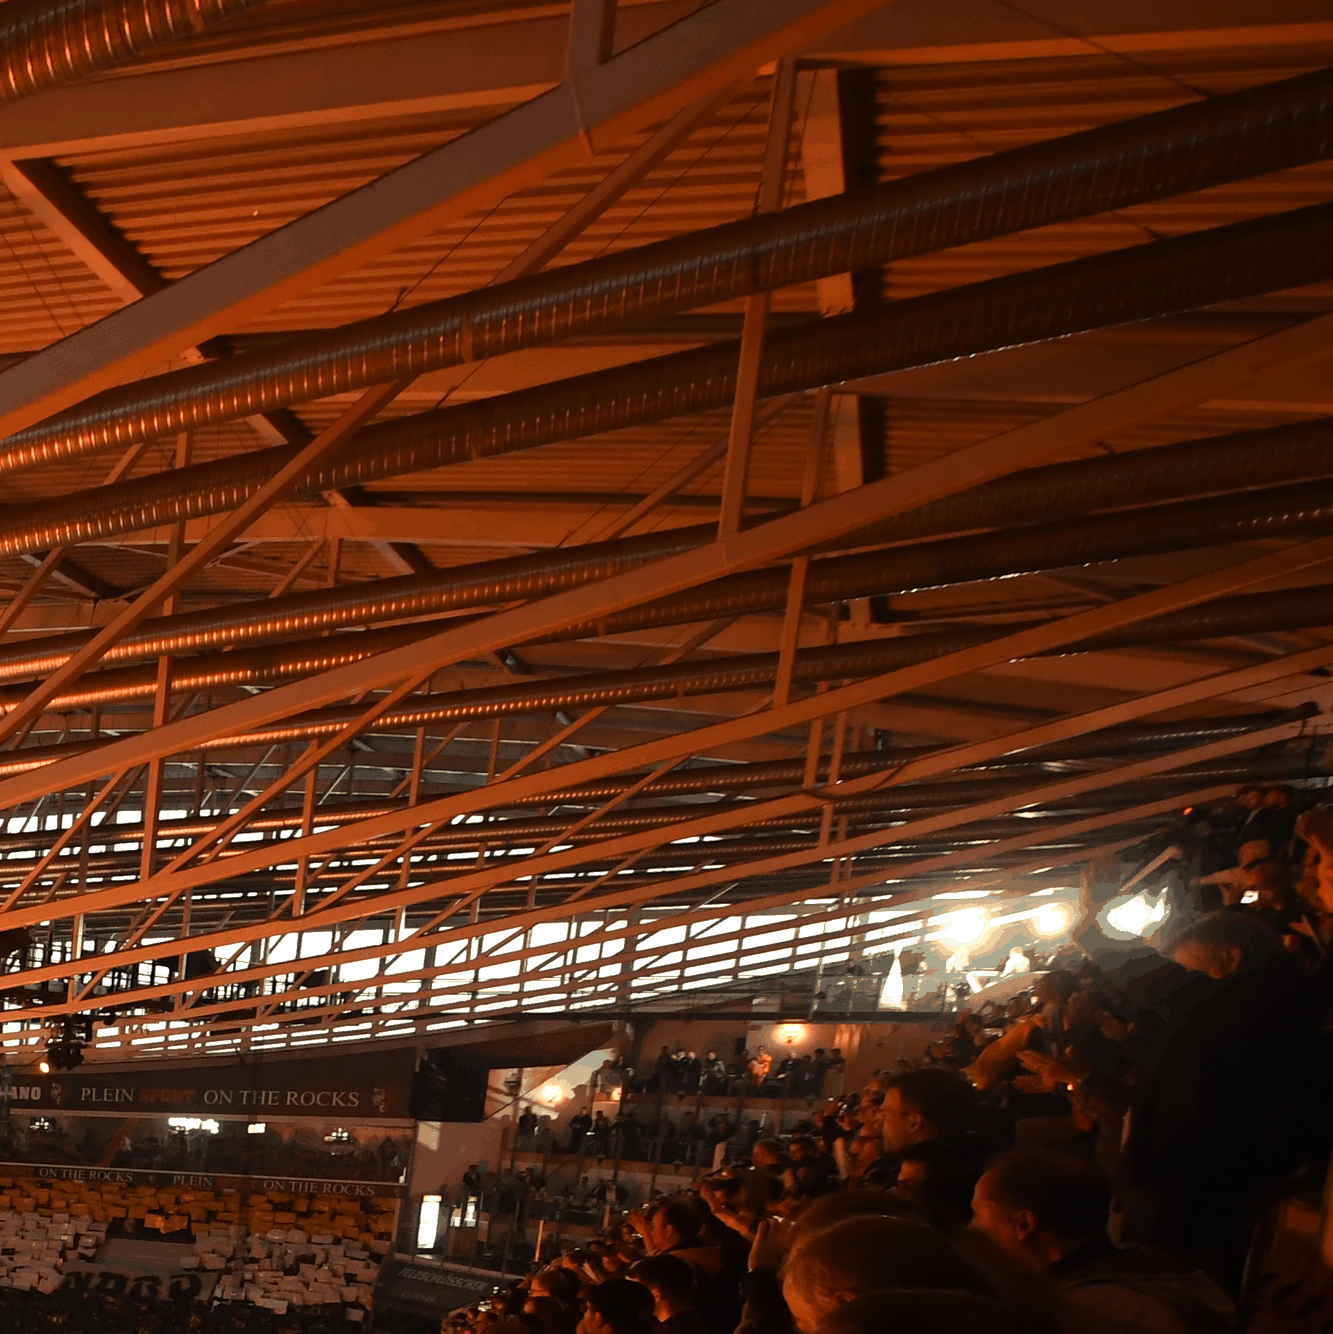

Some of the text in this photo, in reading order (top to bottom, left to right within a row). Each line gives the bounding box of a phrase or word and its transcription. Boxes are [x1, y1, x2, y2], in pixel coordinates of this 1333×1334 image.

[80, 1087, 134, 1102] PLEIN
[203, 1089, 233, 1105] ON
[239, 1090, 280, 1107] THE
[285, 1091, 360, 1108] ROCKS
[39, 1167, 59, 1178] ON
[61, 1168, 86, 1180] THE
[89, 1170, 133, 1182] ROCKS
[173, 1174, 214, 1187] PLEIN
[263, 1179, 287, 1191] ON
[290, 1181, 318, 1193] THE
[322, 1183, 376, 1197] ROCKS
